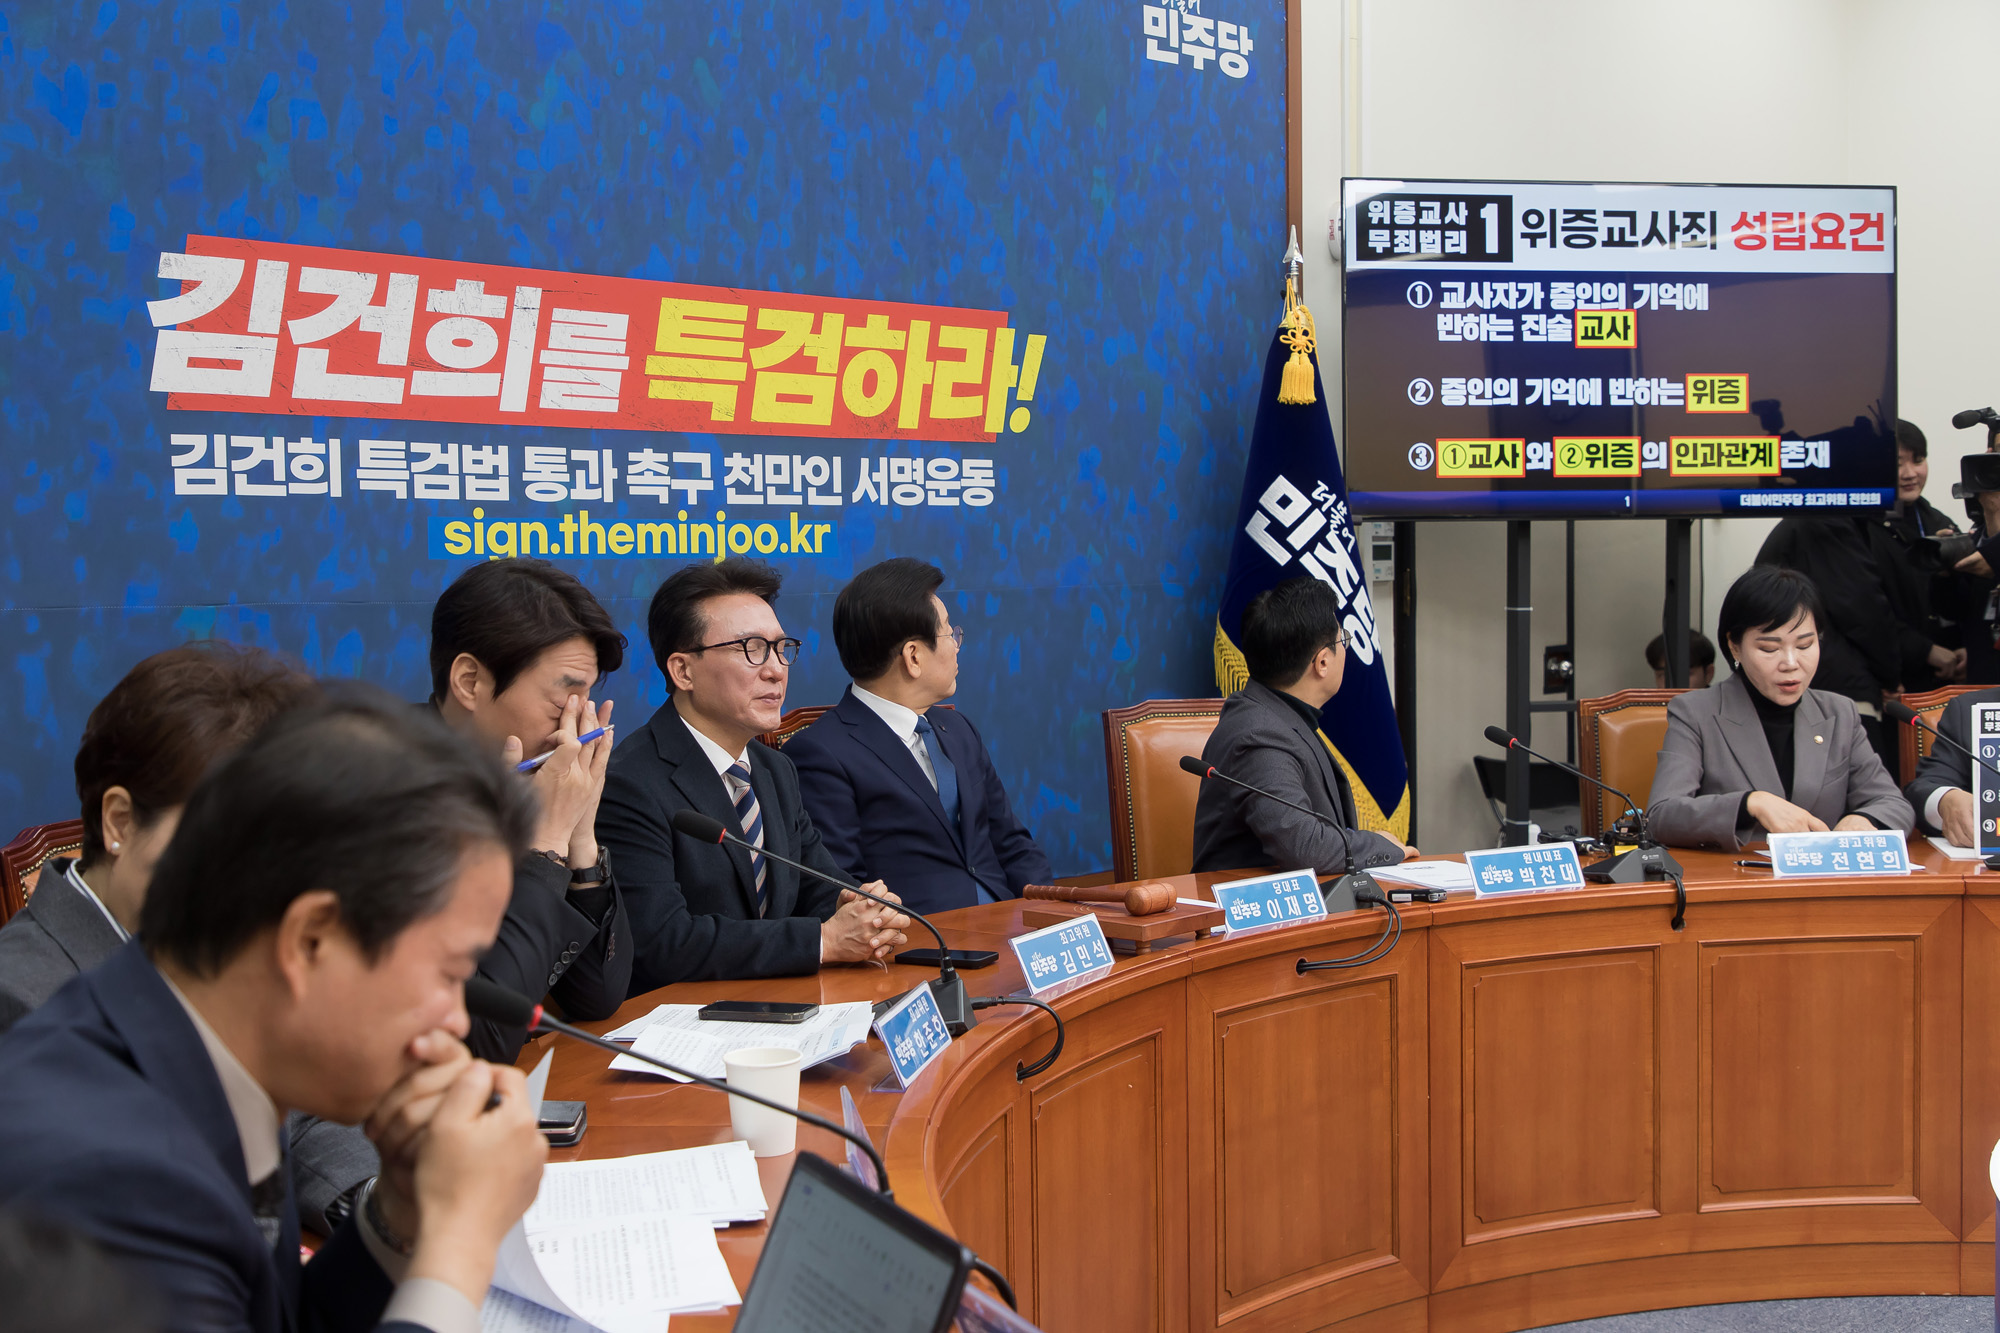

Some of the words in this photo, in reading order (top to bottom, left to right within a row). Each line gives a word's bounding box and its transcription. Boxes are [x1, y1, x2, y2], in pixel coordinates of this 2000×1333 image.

[1143, 5, 1253, 78] 민주당
[1368, 200, 1468, 225] 위증교사
[1368, 229, 1467, 254] 무죄법리
[1480, 203, 1499, 254] 1
[1520, 208, 1717, 250] 위증교사죄
[1730, 211, 1885, 252] 성립요건
[1440, 281, 1544, 309] 교사자가
[1549, 282, 1626, 310] 증인의
[1633, 282, 1709, 310] 기억에
[1437, 313, 1514, 342] 반하는
[1521, 313, 1573, 342] 진술
[1580, 315, 1631, 341] 교사
[146, 251, 630, 413] 김건희를
[644, 297, 1048, 434] 특검하라!
[1441, 377, 1518, 406] 증인의
[1525, 377, 1602, 406] 기억에
[1609, 377, 1685, 406] 반하는
[1692, 379, 1740, 405] 위증
[1675, 442, 1773, 468] 인과관계
[1780, 440, 1830, 469] 존재
[170, 434, 342, 498] 김건희
[356, 439, 510, 501] 특검법
[522, 445, 618, 503] 통과
[626, 448, 714, 505] 촉구
[723, 452, 843, 506] 천만인
[852, 456, 996, 507] 서명운동
[1624, 495, 1631, 508] 1
[1311, 480, 1356, 553] 더불어
[444, 507, 831, 565] sign.theminjoo.kr
[1245, 474, 1382, 666] 민주당
[1838, 836, 1888, 848] 최고위원
[1522, 850, 1562, 864] 원내대표
[1784, 852, 1823, 866] 민주당
[1831, 850, 1901, 870] 전현희
[1272, 879, 1301, 895] 당대표
[1481, 868, 1514, 885] 민주당
[1519, 863, 1577, 886] 박찬대
[1230, 902, 1261, 921] 민주당
[1266, 892, 1319, 919] 이재명
[1059, 923, 1091, 945] 최고위원
[1030, 955, 1058, 978] 민주당
[1060, 939, 1108, 975] 김민석
[913, 1014, 946, 1058] 한준호
